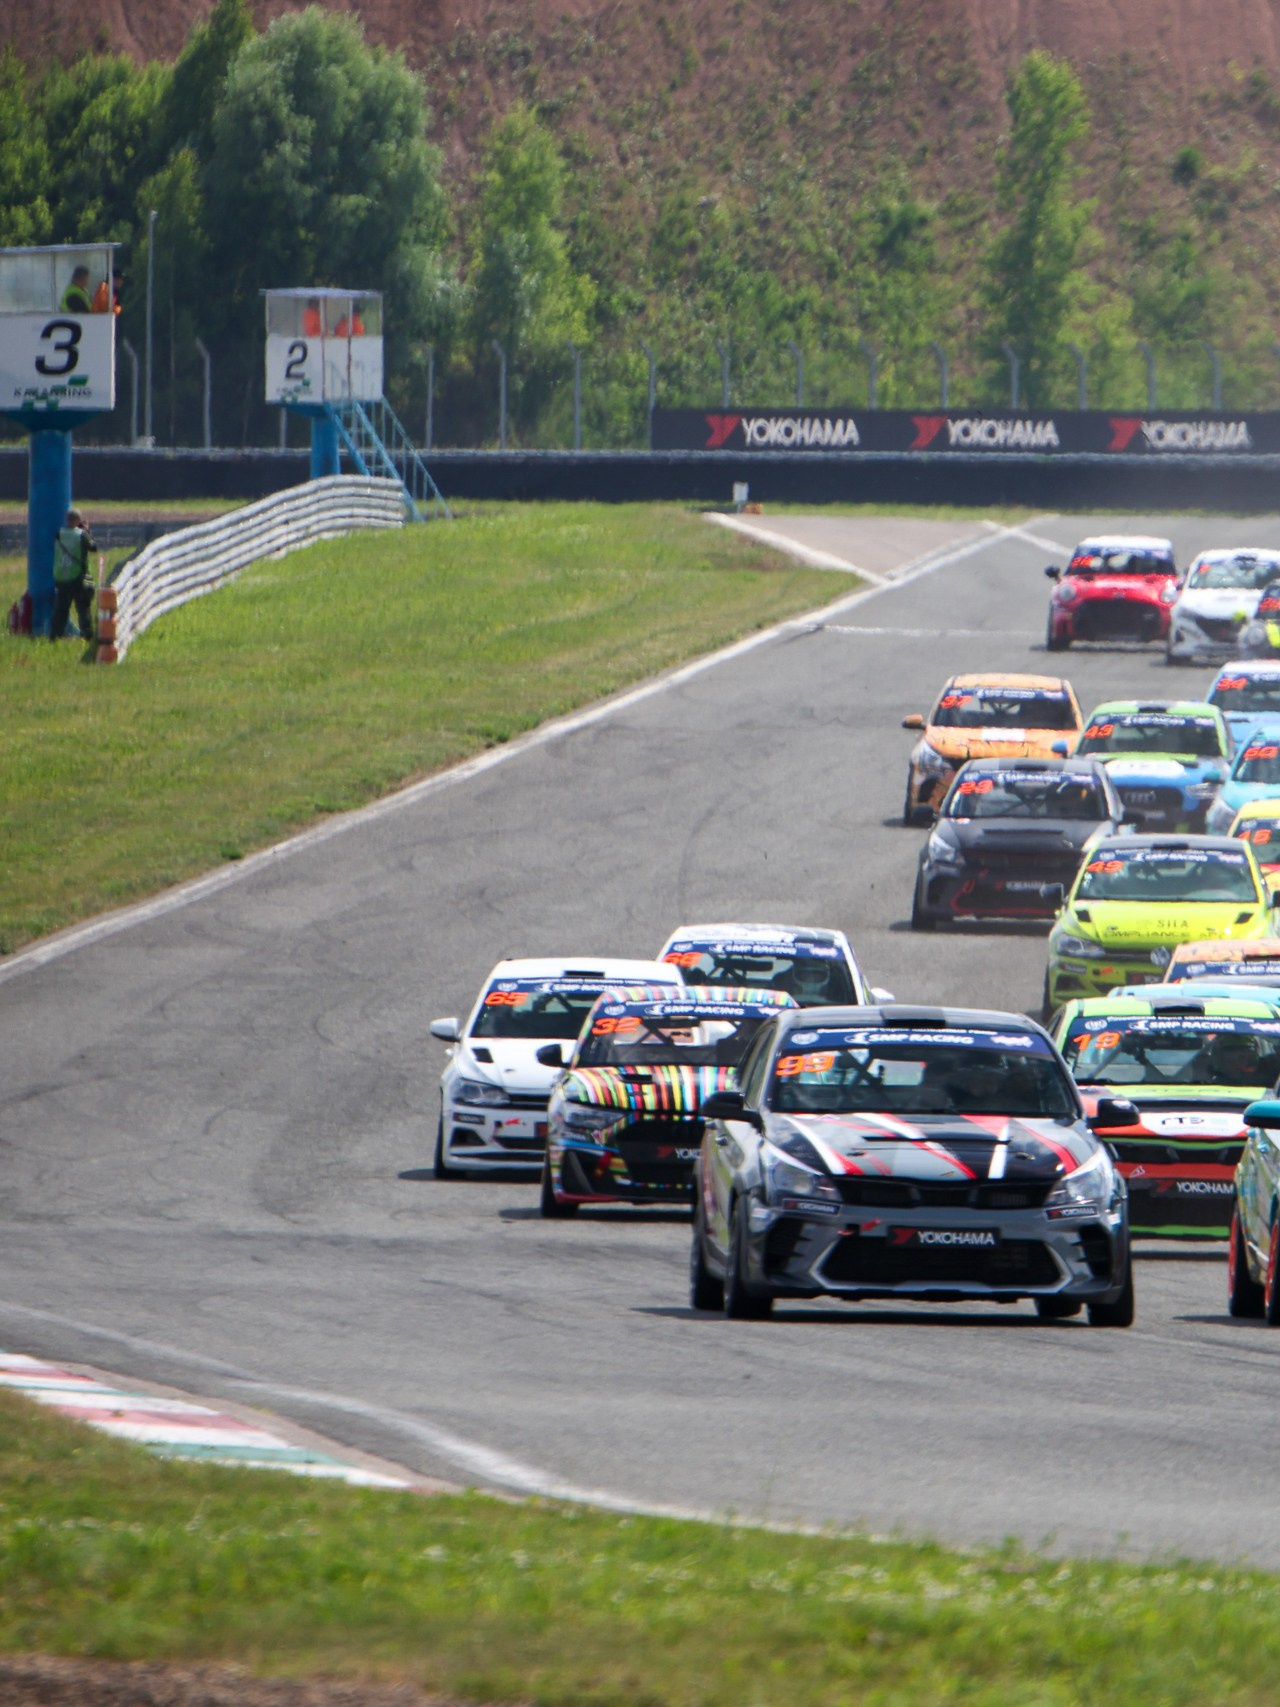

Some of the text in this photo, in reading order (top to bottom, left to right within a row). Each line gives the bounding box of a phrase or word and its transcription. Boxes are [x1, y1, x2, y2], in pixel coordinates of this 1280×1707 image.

[35, 319, 83, 375] 3
[285, 340, 308, 379] 2
[742, 417, 860, 446] YOKOHAMA
[947, 418, 1060, 446] YOKOHAMA
[485, 992, 528, 1005] 65
[664, 1005, 744, 1015] SMP RACING
[592, 1017, 642, 1035] 32
[1149, 1021, 1235, 1031] SMP RACING
[868, 1033, 974, 1044] SMP RACING
[1073, 1032, 1121, 1050] 19
[776, 1055, 835, 1077] 99
[1176, 1182, 1234, 1194] YOKOHAM
[1059, 1207, 1095, 1217] YOKOHAMA
[918, 1231, 995, 1246] YOKOHAMA
